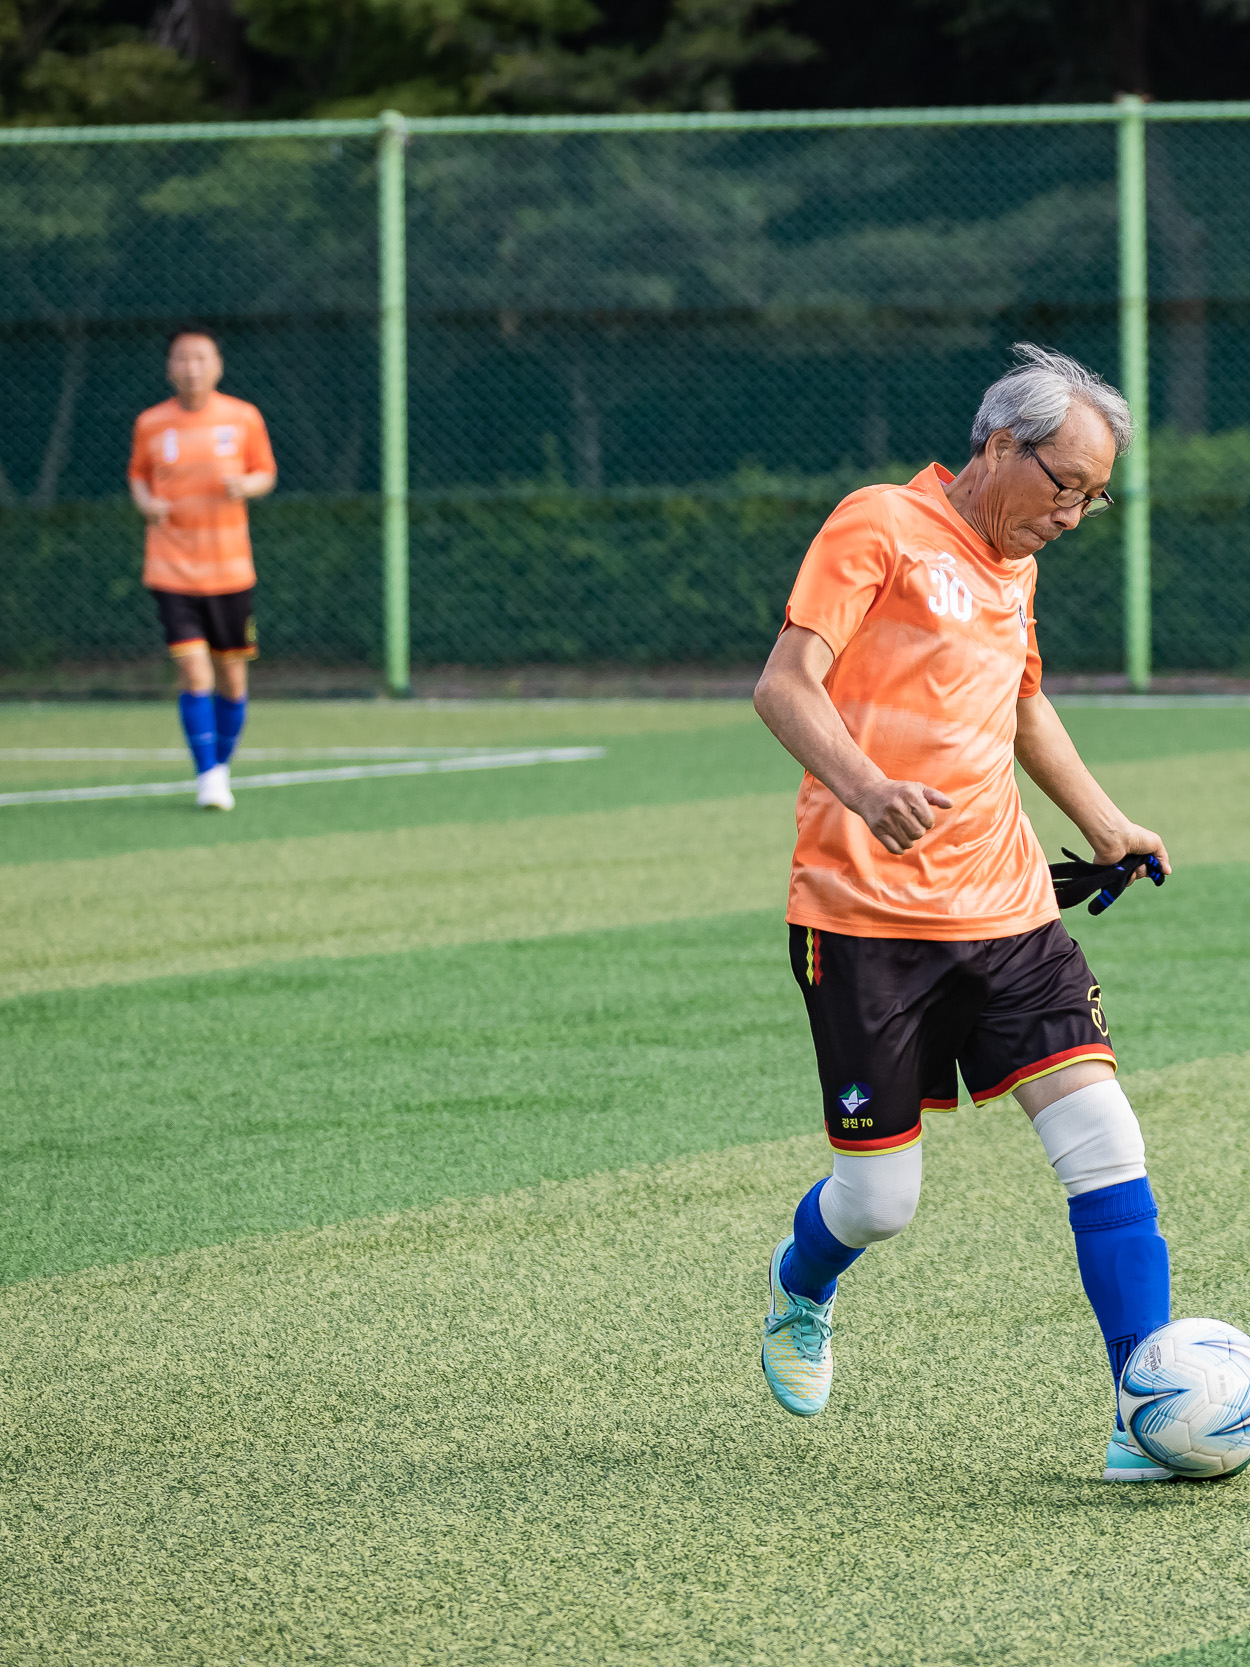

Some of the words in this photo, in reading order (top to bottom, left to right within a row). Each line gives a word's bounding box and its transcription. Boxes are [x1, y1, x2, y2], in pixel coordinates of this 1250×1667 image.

[928, 569, 973, 622] 30
[841, 1117, 859, 1129] 광진
[860, 1117, 873, 1128] 70
